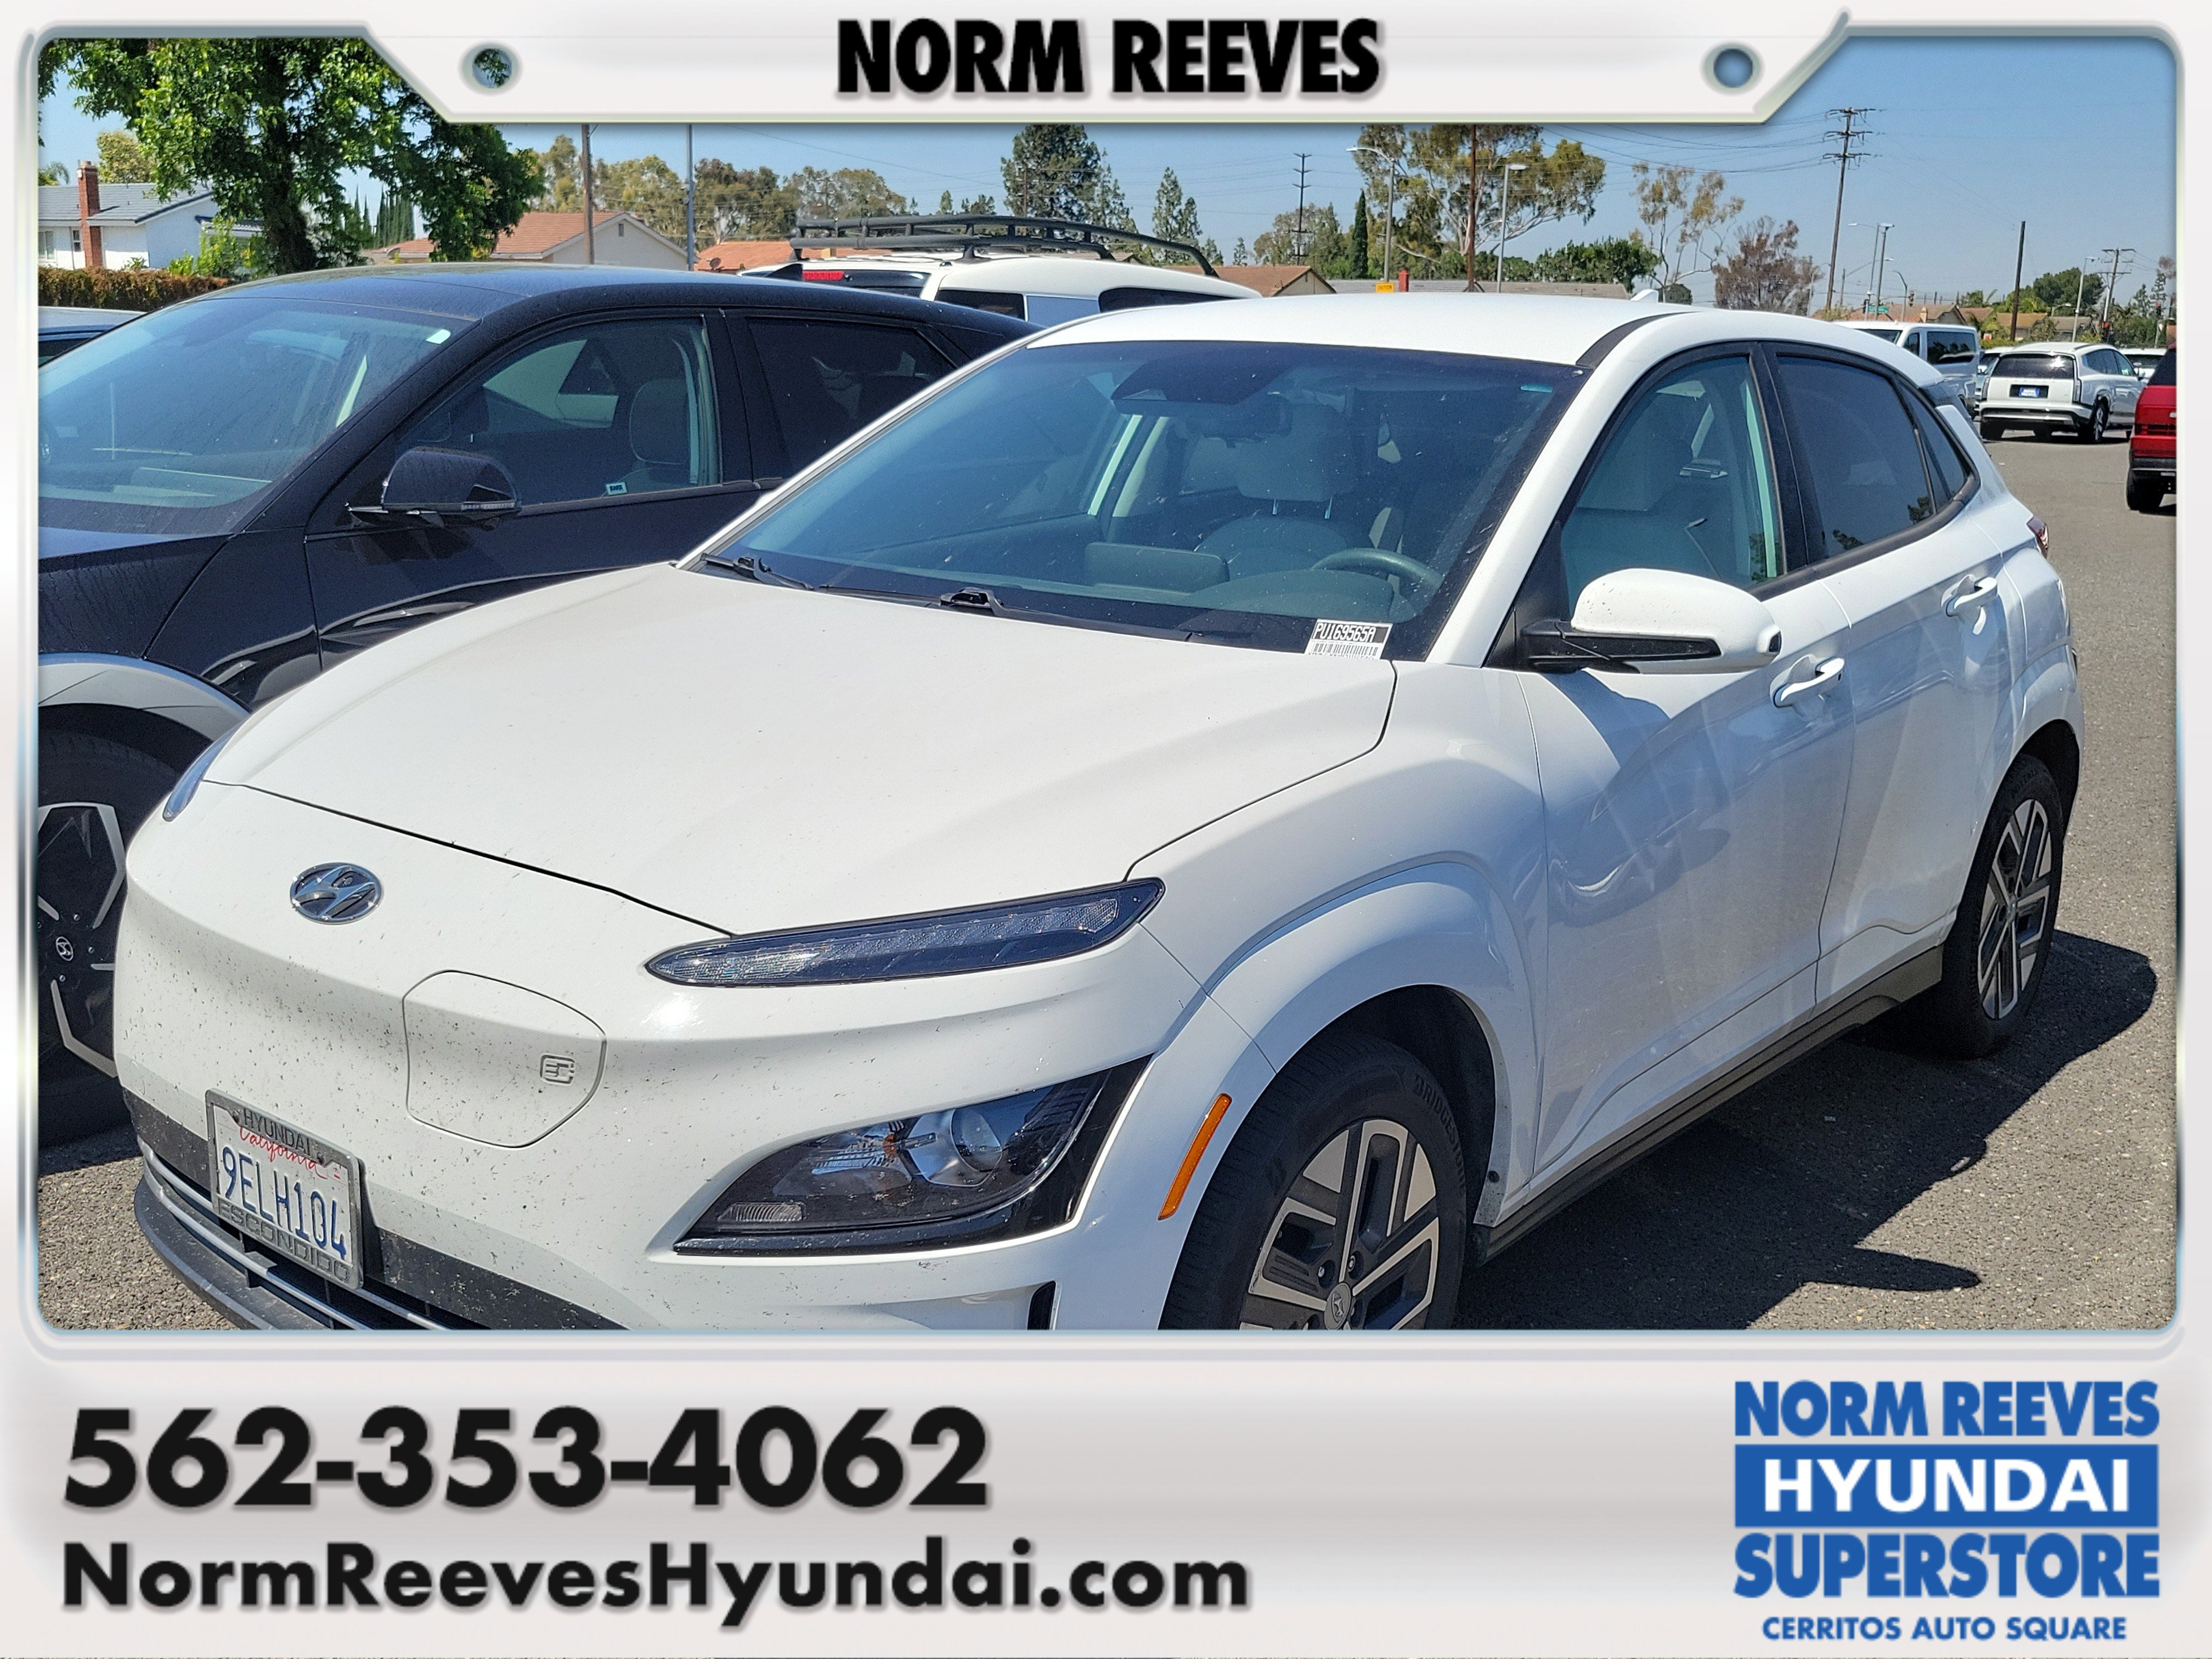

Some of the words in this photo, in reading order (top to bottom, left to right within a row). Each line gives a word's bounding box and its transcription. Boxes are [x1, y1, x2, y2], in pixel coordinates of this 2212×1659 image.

[1312, 622, 1377, 643] PU169565A
[244, 1107, 311, 1156] HYUNDAI
[222, 1146, 347, 1261] 9ELH104
[219, 1199, 351, 1283] ESCONDIDO
